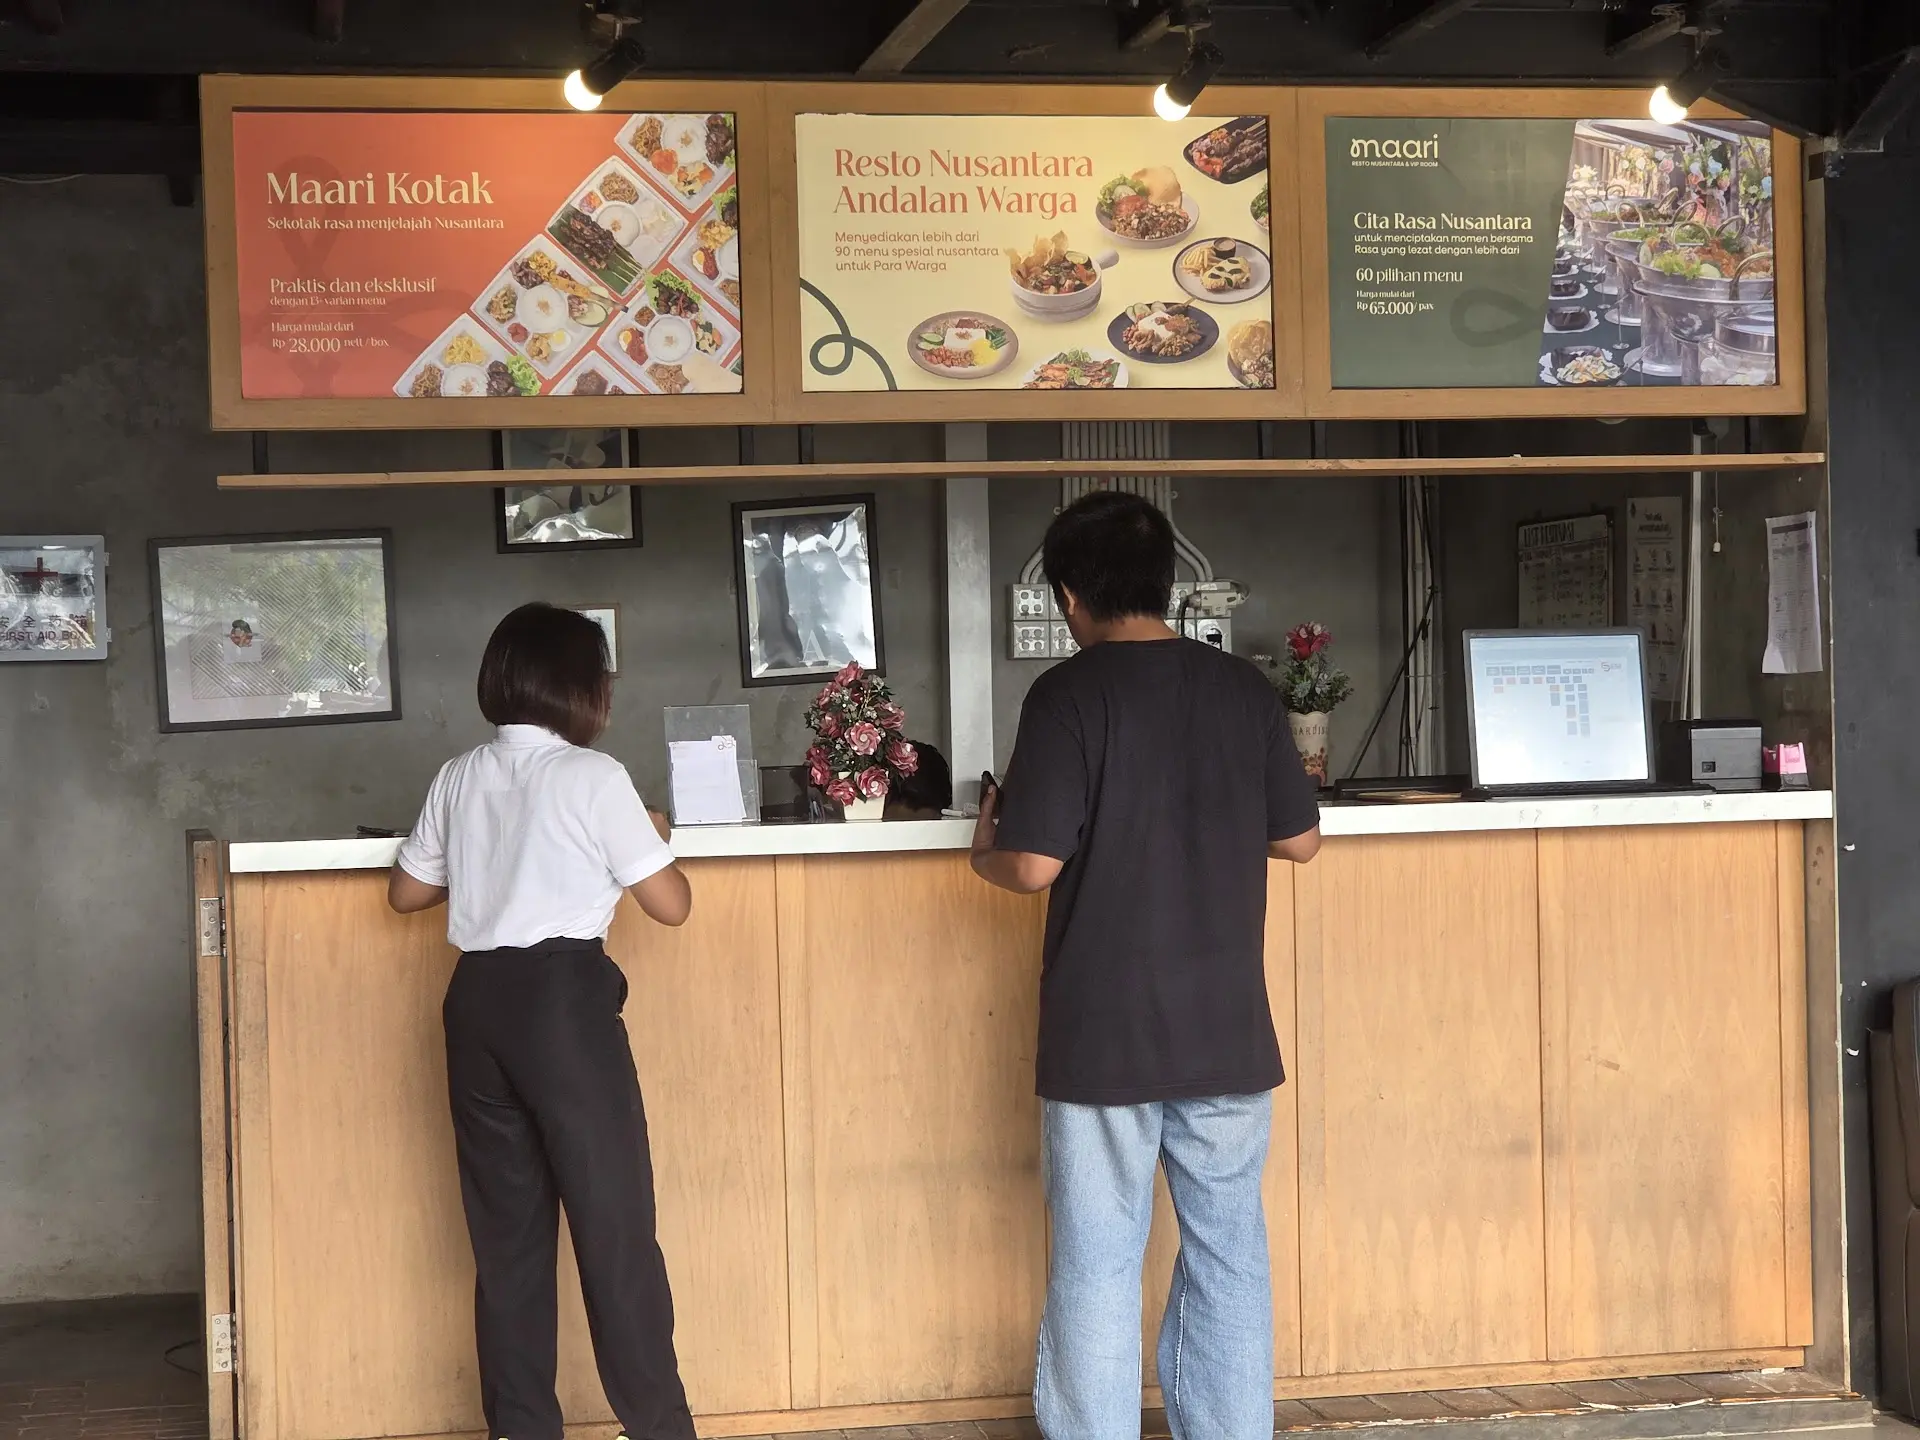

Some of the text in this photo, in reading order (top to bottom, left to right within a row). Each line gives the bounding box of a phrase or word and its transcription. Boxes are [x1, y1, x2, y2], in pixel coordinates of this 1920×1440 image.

[1350, 133, 1438, 158] maari
[834, 148, 1093, 177] Resto Nusantara
[266, 171, 494, 204] Maari Kotak
[833, 185, 1078, 220] Andalan Warga
[267, 216, 505, 231] Sekotak rasa menjelajah Nusantara
[1353, 211, 1532, 230] Cita Rasa Nusantara
[835, 231, 980, 245] Menyediakan lebih dari
[1354, 233, 1534, 244] untuk menciptakan momen bersama
[835, 246, 999, 259] 90 menu spesial nusantara
[1354, 244, 1520, 256] Rasa yang lezat dengan lebih dari
[836, 261, 947, 273] untuk Para Warga
[1355, 267, 1463, 284] 60 pilihan menu
[270, 277, 437, 293] Praktis dan eksklusif
[1356, 290, 1415, 299] Harga mulai dari
[269, 296, 309, 308] dengan
[323, 297, 355, 306] varian
[357, 297, 386, 306] menu
[1356, 301, 1368, 311] Rp
[1418, 303, 1435, 311] pax
[271, 322, 354, 334] Harga mulai dari
[272, 337, 285, 349] Rp
[288, 337, 341, 353] 28.000
[344, 338, 363, 347] nett
[37, 630, 57, 641] AID
[61, 629, 82, 641] BO
